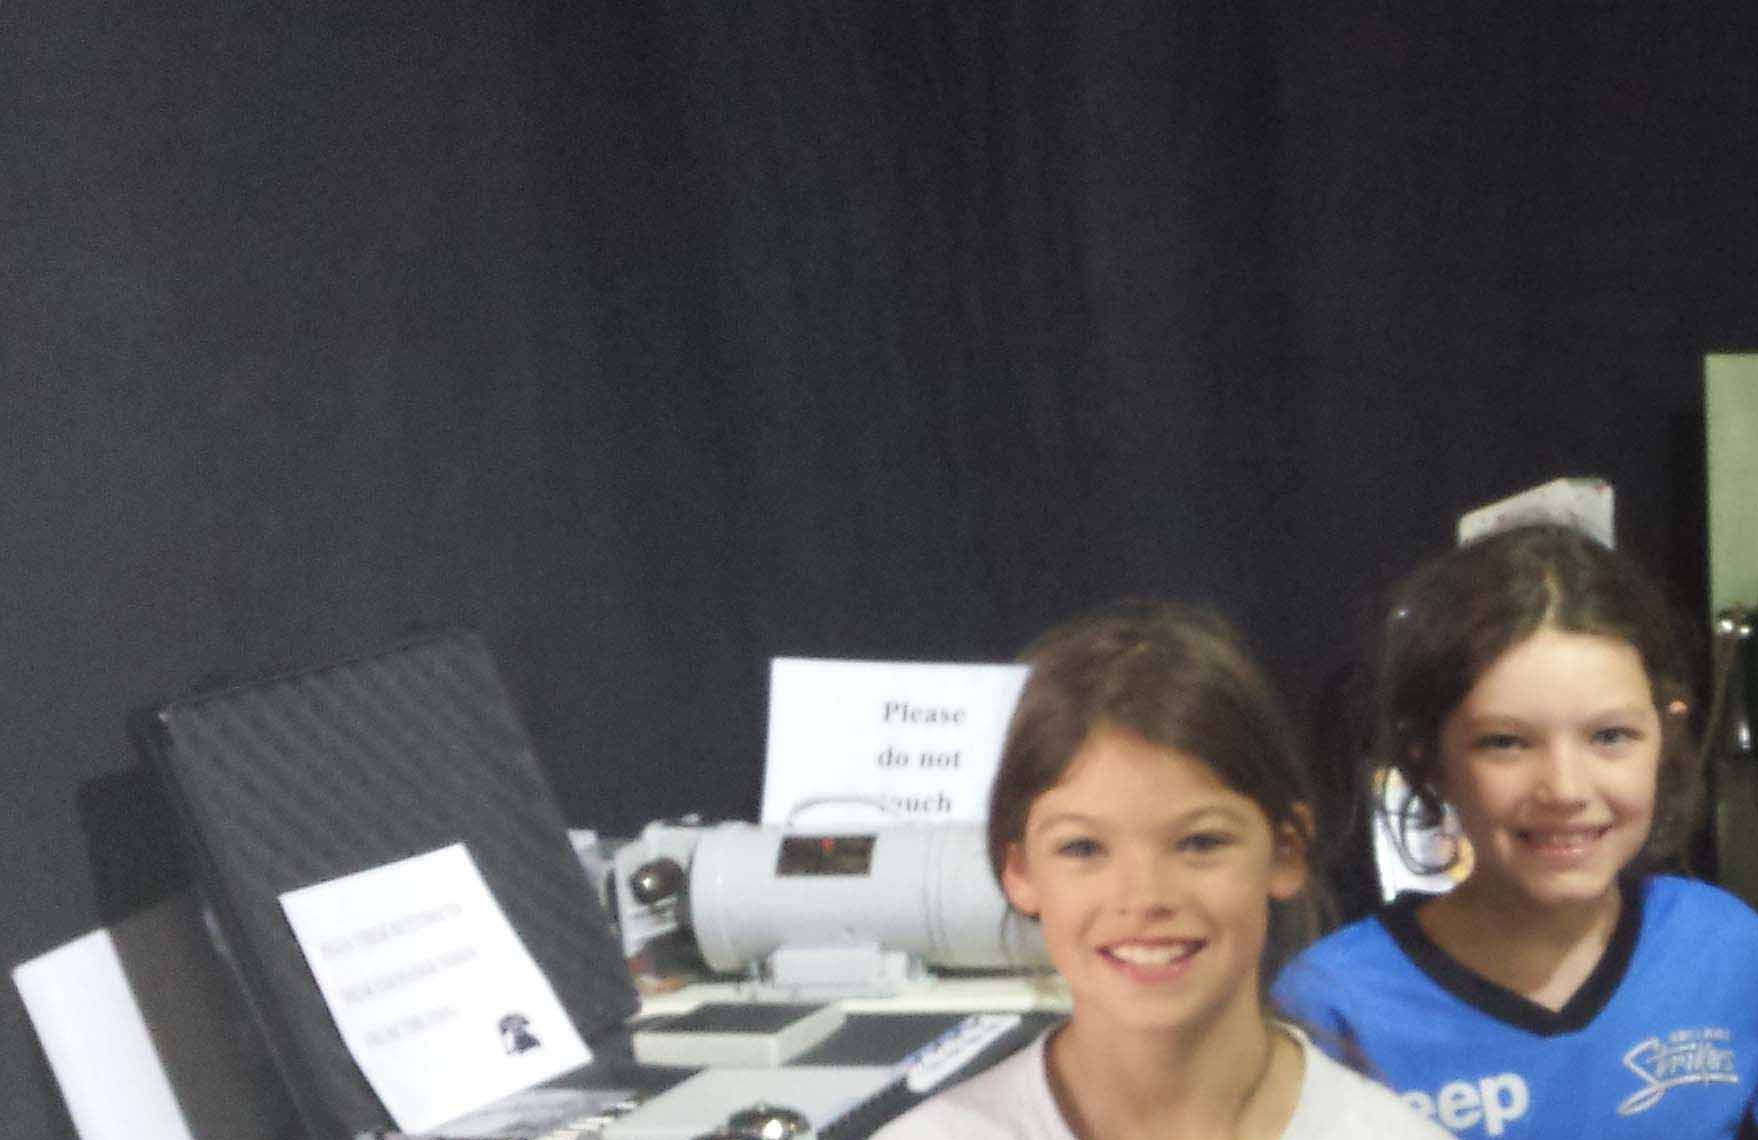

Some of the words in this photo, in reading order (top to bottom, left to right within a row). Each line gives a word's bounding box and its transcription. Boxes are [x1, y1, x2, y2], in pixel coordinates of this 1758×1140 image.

[882, 700, 966, 723] Please
[877, 748, 910, 767] do
[919, 751, 961, 768] not
